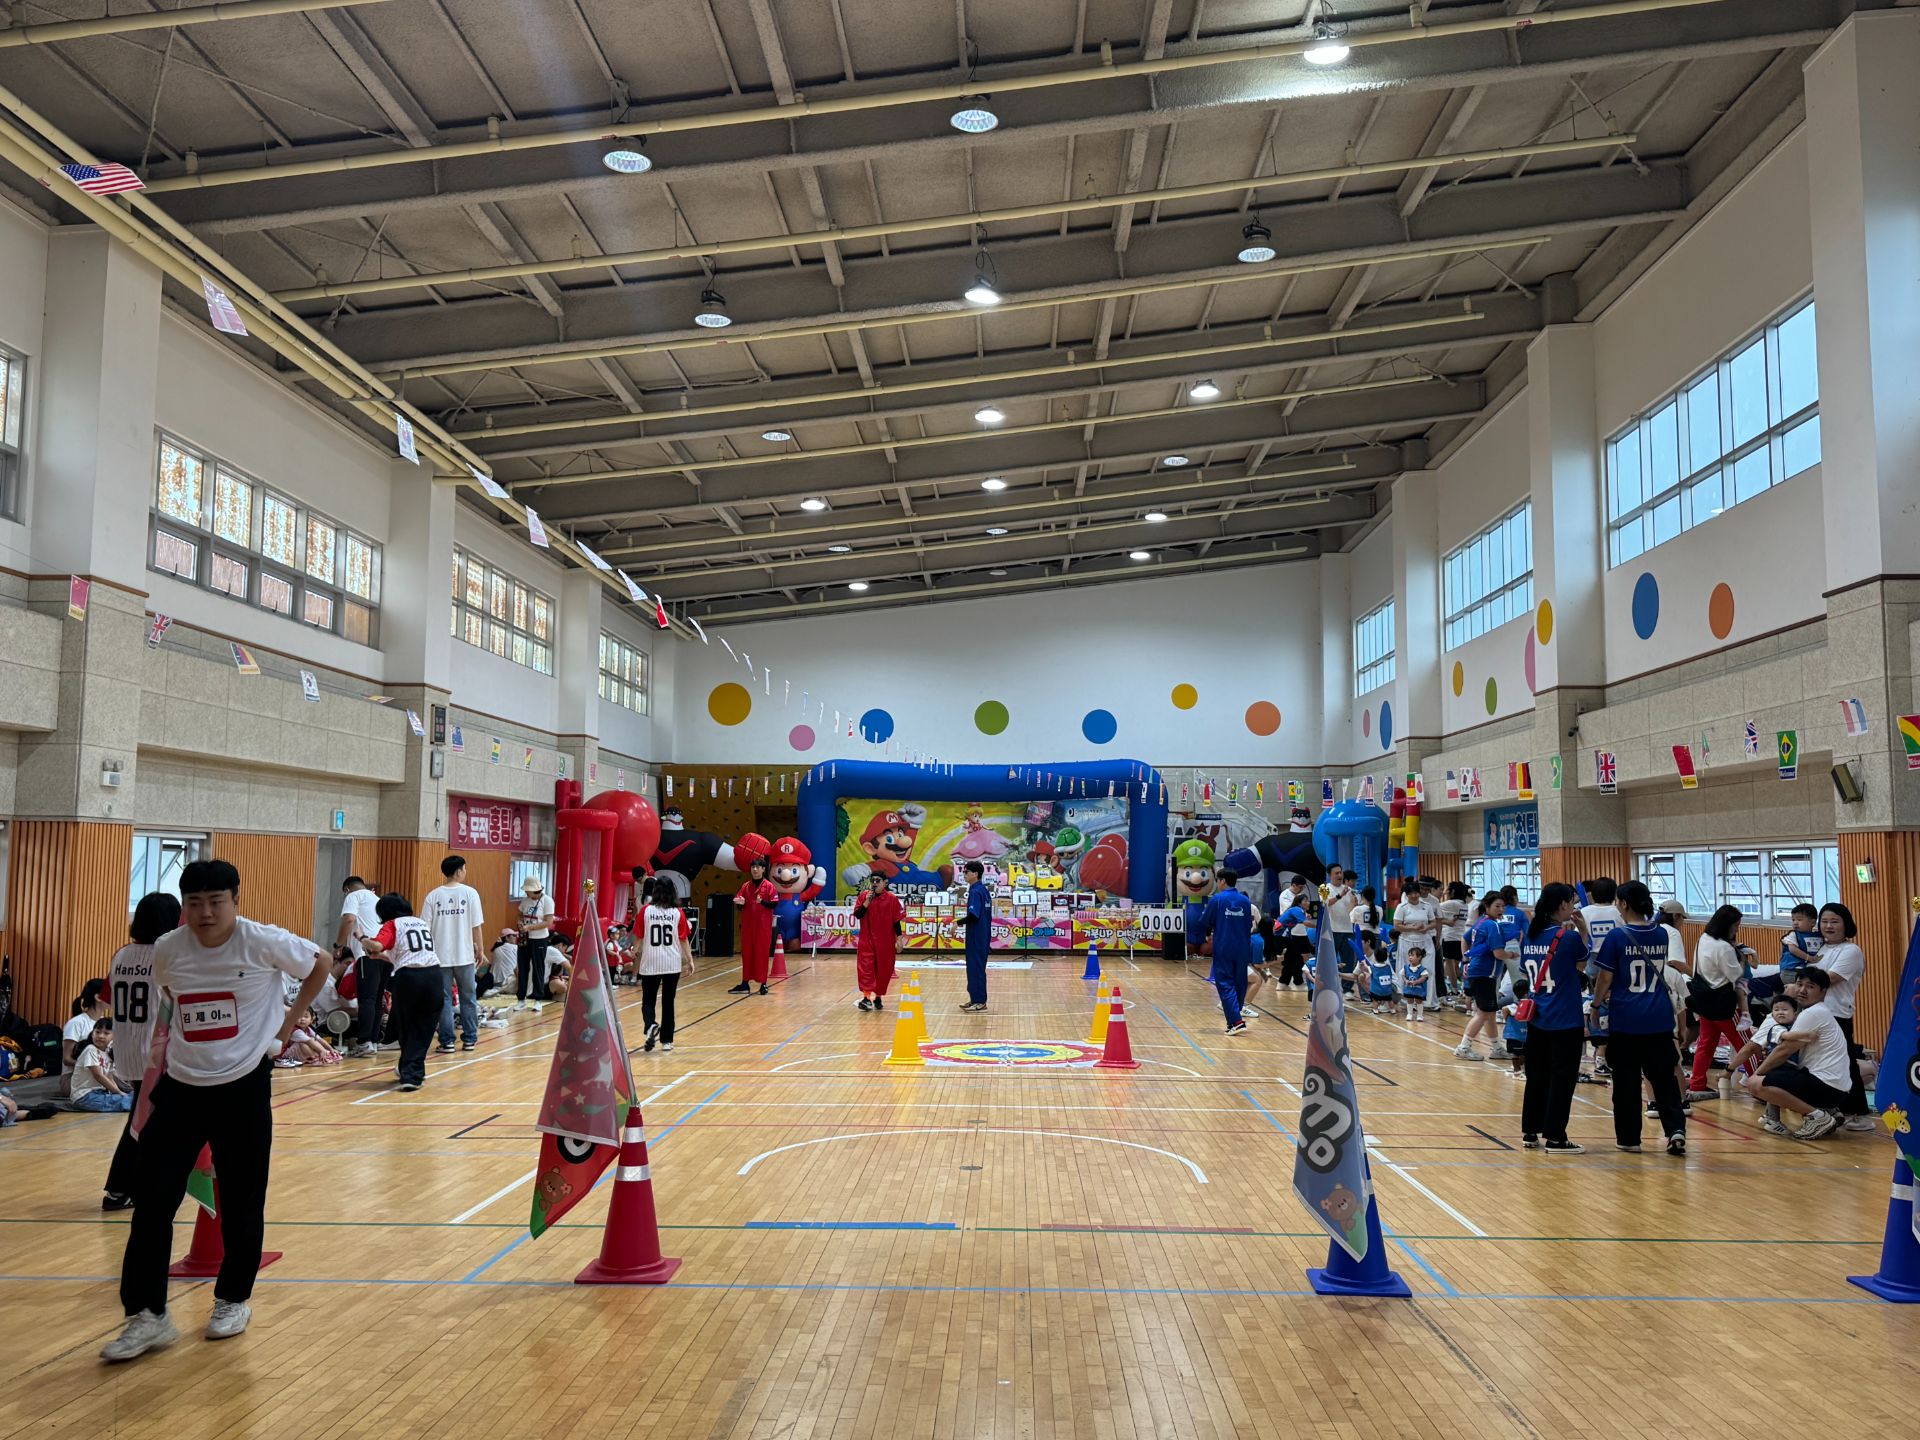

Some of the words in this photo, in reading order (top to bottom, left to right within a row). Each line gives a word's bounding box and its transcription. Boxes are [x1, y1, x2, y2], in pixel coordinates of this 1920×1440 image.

[470, 817, 488, 844] 무적
[490, 806, 512, 844] 홍팀
[1500, 824, 1515, 850] 최강
[1515, 811, 1538, 850] 청팀
[437, 908, 465, 917] STUDIO
[1142, 915, 1182, 931] 0000
[406, 930, 433, 952] 09
[651, 924, 673, 947] 06
[115, 964, 152, 976] HanSol
[1524, 959, 1556, 993] 04
[1629, 960, 1666, 993] 07
[114, 981, 149, 1023] 08
